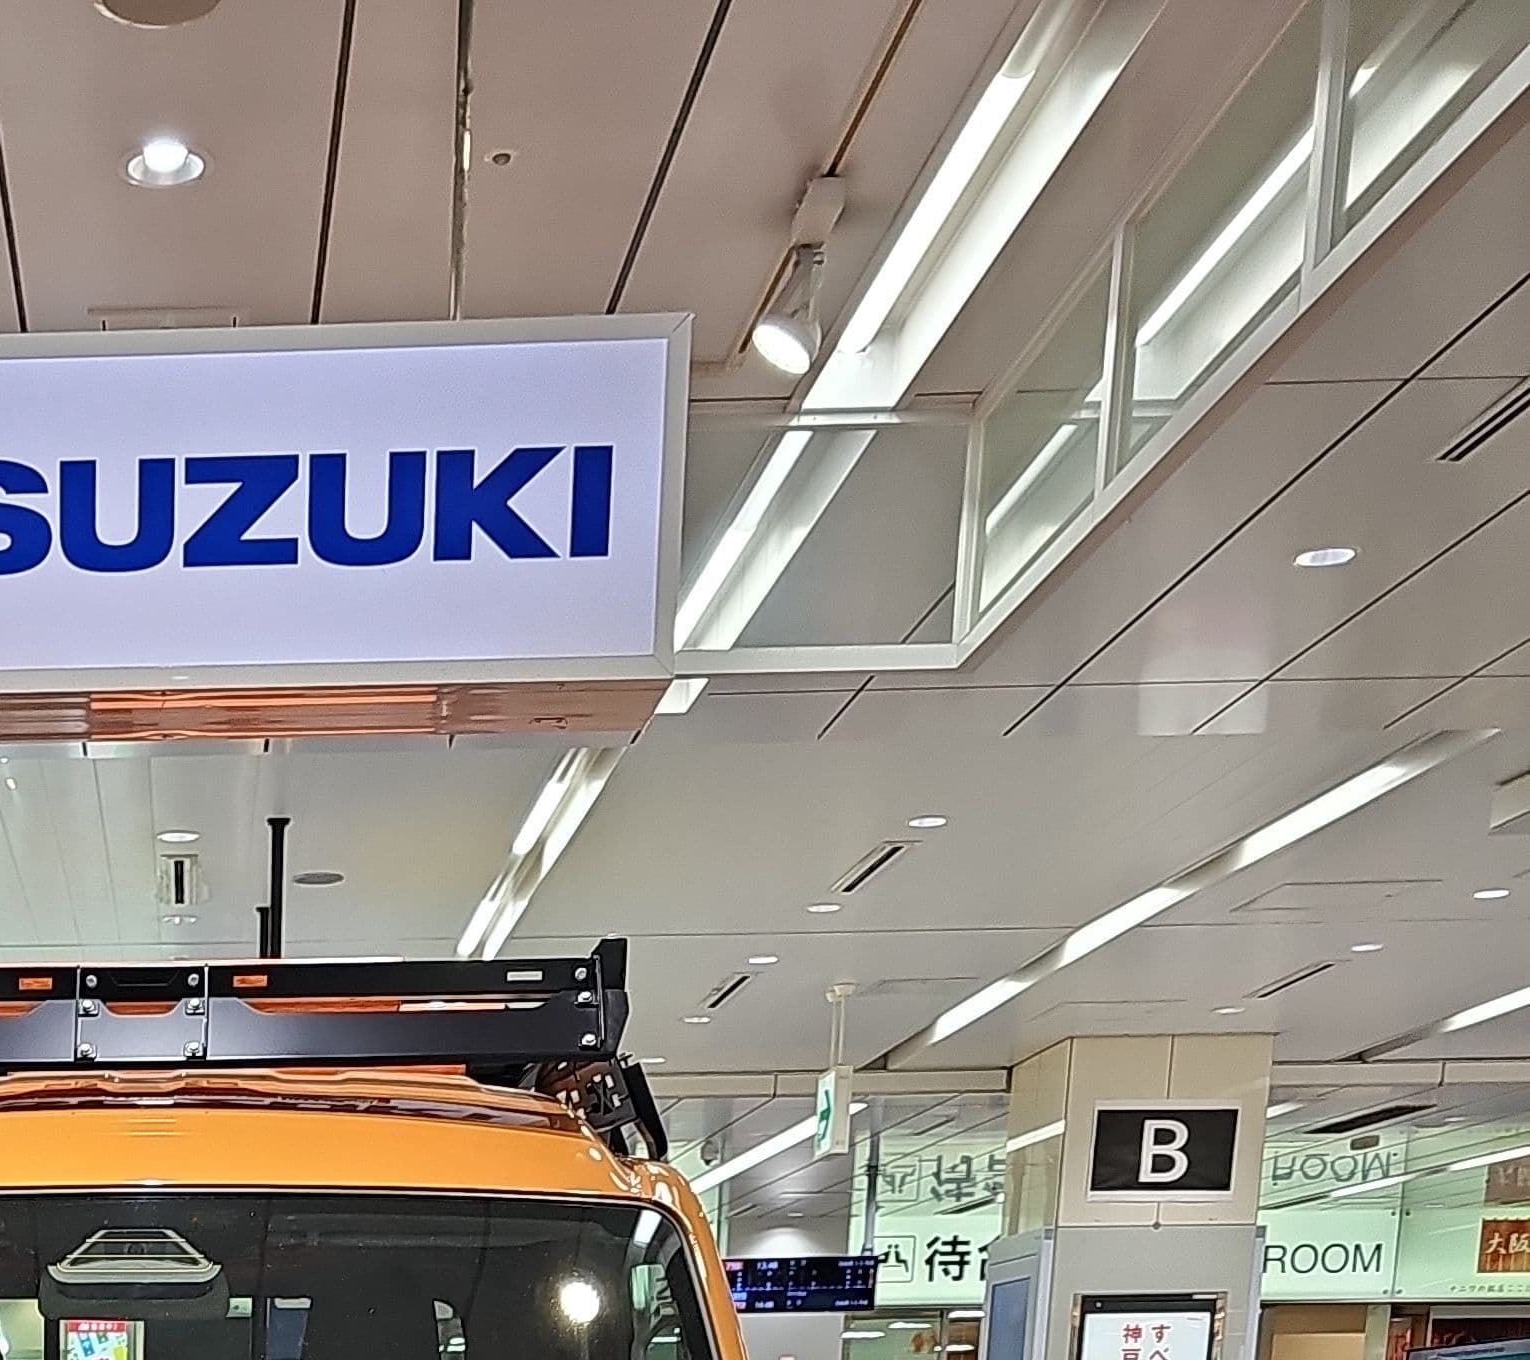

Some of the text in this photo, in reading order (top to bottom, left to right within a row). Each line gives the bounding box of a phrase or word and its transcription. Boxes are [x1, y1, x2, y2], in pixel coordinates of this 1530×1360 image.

[1137, 1119, 1189, 1183] B
[925, 1235, 988, 1282] 待
[1262, 1243, 1383, 1274] ROOM
